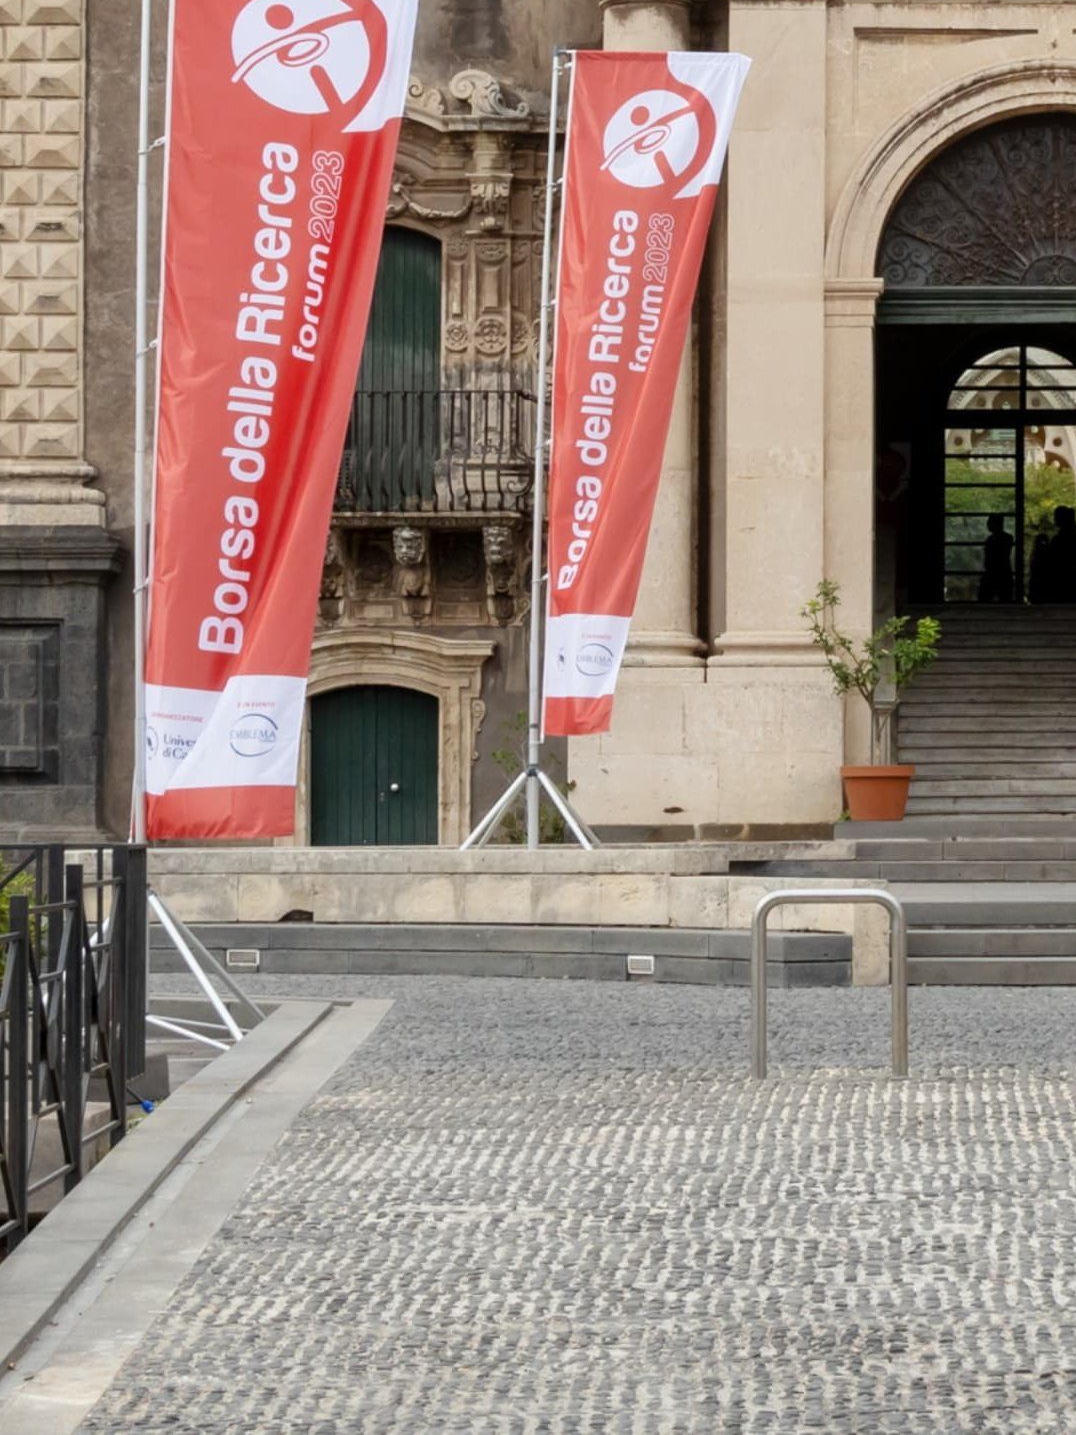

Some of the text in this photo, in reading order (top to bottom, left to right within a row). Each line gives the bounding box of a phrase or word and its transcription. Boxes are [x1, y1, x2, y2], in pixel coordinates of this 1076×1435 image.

[292, 149, 345, 362] forum 2023
[588, 209, 640, 364] Ricerca
[628, 213, 675, 373] forum 2023
[199, 141, 300, 655] Borsa della Ricerca
[575, 371, 618, 467] della
[556, 476, 602, 591] Borsa
